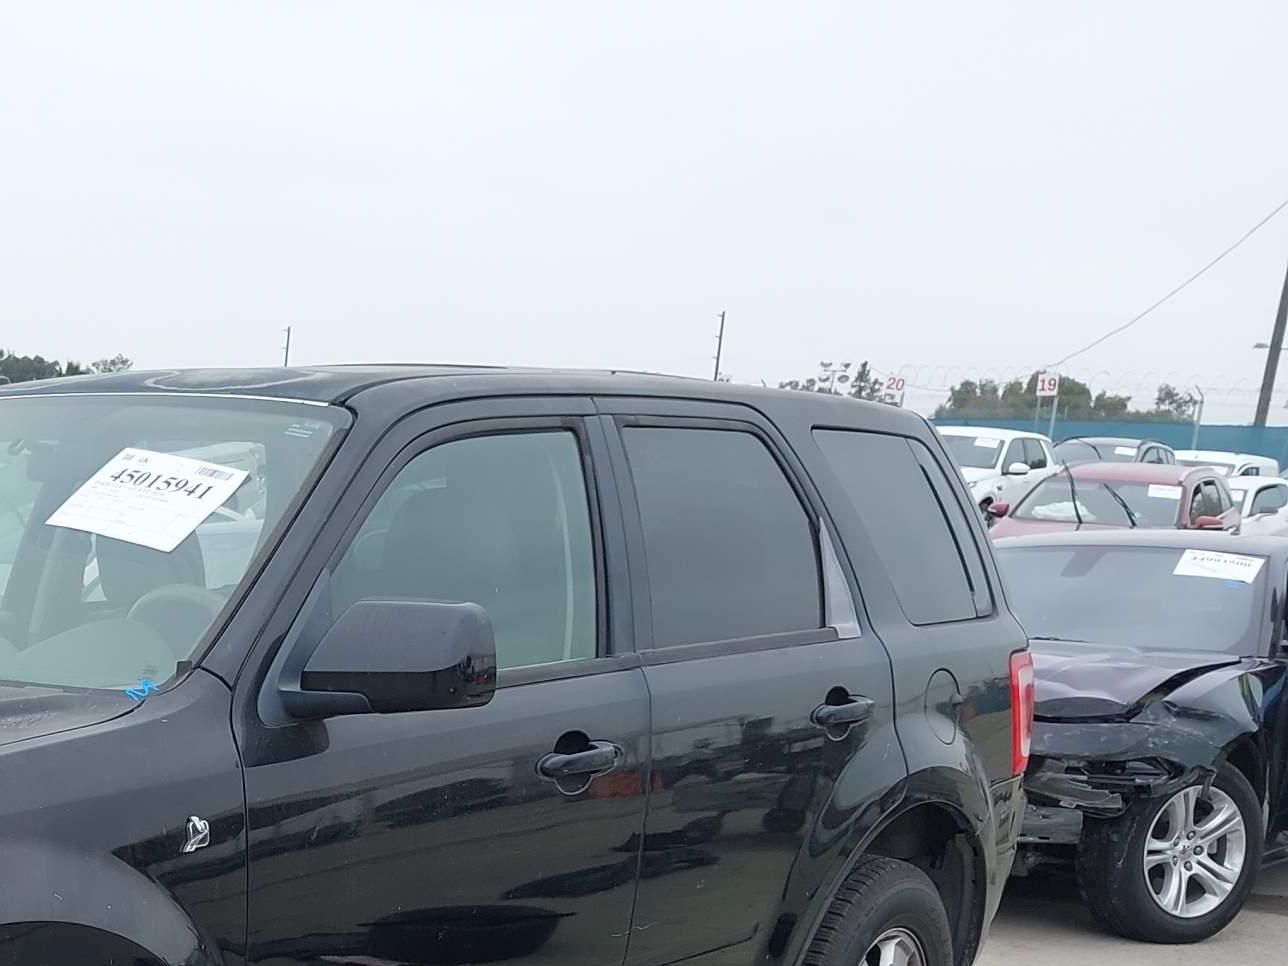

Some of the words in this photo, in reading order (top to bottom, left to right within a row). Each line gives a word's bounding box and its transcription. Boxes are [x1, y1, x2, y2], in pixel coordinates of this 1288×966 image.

[886, 377, 905, 391] 20
[1038, 378, 1057, 392] 19
[110, 467, 215, 500] 45015941
